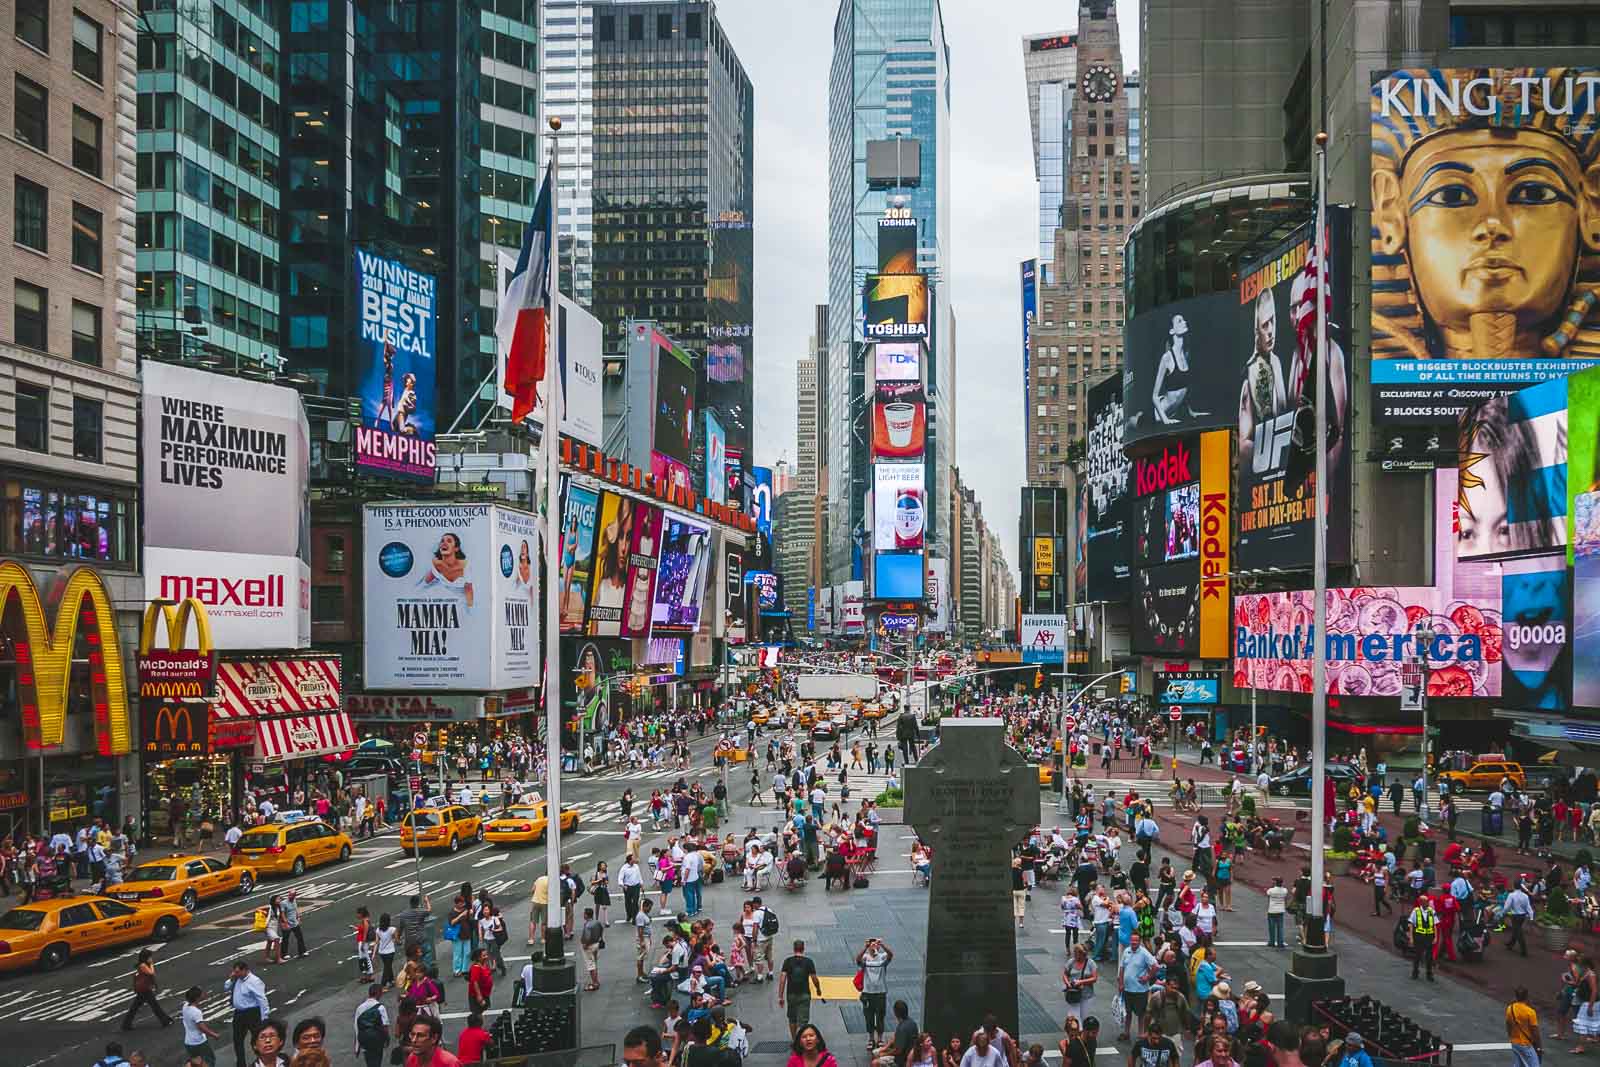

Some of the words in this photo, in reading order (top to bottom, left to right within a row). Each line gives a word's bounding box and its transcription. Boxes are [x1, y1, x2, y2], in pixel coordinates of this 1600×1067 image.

[1380, 78, 1496, 117] KING
[1511, 77, 1600, 115] TUT
[884, 208, 912, 218] 2010
[358, 250, 434, 297] WINNER!
[362, 288, 431, 338] BEST
[362, 320, 432, 358] MUSICAL
[867, 324, 926, 335] TOSHIBA
[888, 354, 916, 364] TDK
[578, 364, 596, 383] TOUS
[161, 397, 224, 424] WHERE
[161, 415, 286, 458] MAXIMUM
[356, 427, 436, 468] MEMPHIS
[161, 442, 286, 474] PERFORMANCE
[1137, 440, 1191, 496] Kodak
[161, 461, 223, 490] LIVES
[1252, 484, 1272, 510] SAT.
[384, 519, 394, 527] IS
[395, 519, 402, 527] A
[396, 508, 447, 518] FEEL-GOOD
[448, 507, 488, 517] MUSICAL
[568, 500, 595, 528] HUGE
[1258, 508, 1268, 528] ON
[1270, 497, 1317, 526] PAY-PER-VI
[1202, 493, 1226, 600] Kodak
[1036, 561, 1052, 569] KING
[161, 574, 284, 607] maxell
[397, 604, 460, 628] MAMMA
[505, 602, 529, 626] MAMMA
[882, 616, 918, 625] YAHOO!
[410, 630, 447, 655] MIA!
[510, 628, 525, 650] MIA!
[1237, 625, 1280, 659] Bank
[1282, 624, 1302, 660] of
[1304, 623, 1482, 662] America
[140, 660, 208, 669] McDonald's
[248, 686, 276, 695] FRIDAY'S
